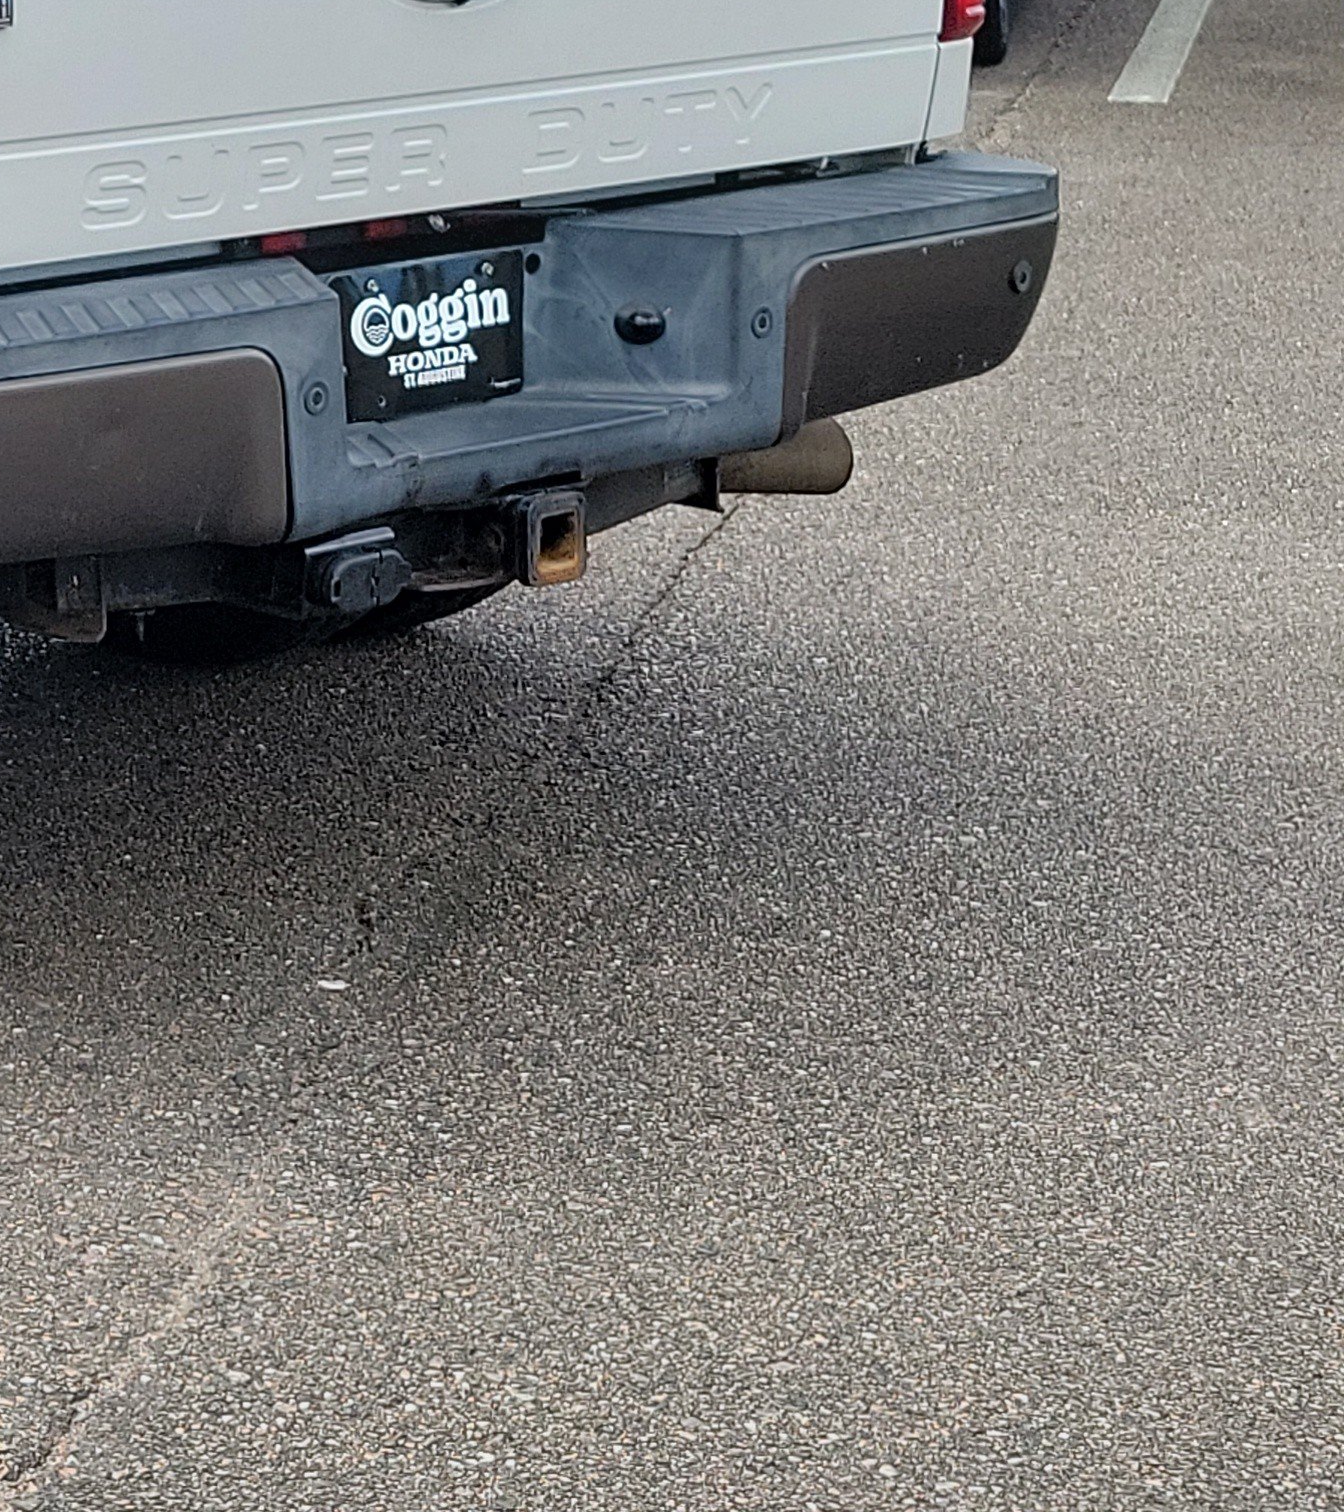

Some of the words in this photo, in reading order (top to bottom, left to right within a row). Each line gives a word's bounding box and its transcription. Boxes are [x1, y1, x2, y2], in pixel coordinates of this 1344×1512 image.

[79, 124, 449, 231] SUPER
[521, 82, 774, 176] DUTY
[350, 278, 511, 358] Coggin
[387, 343, 479, 377] HONDA
